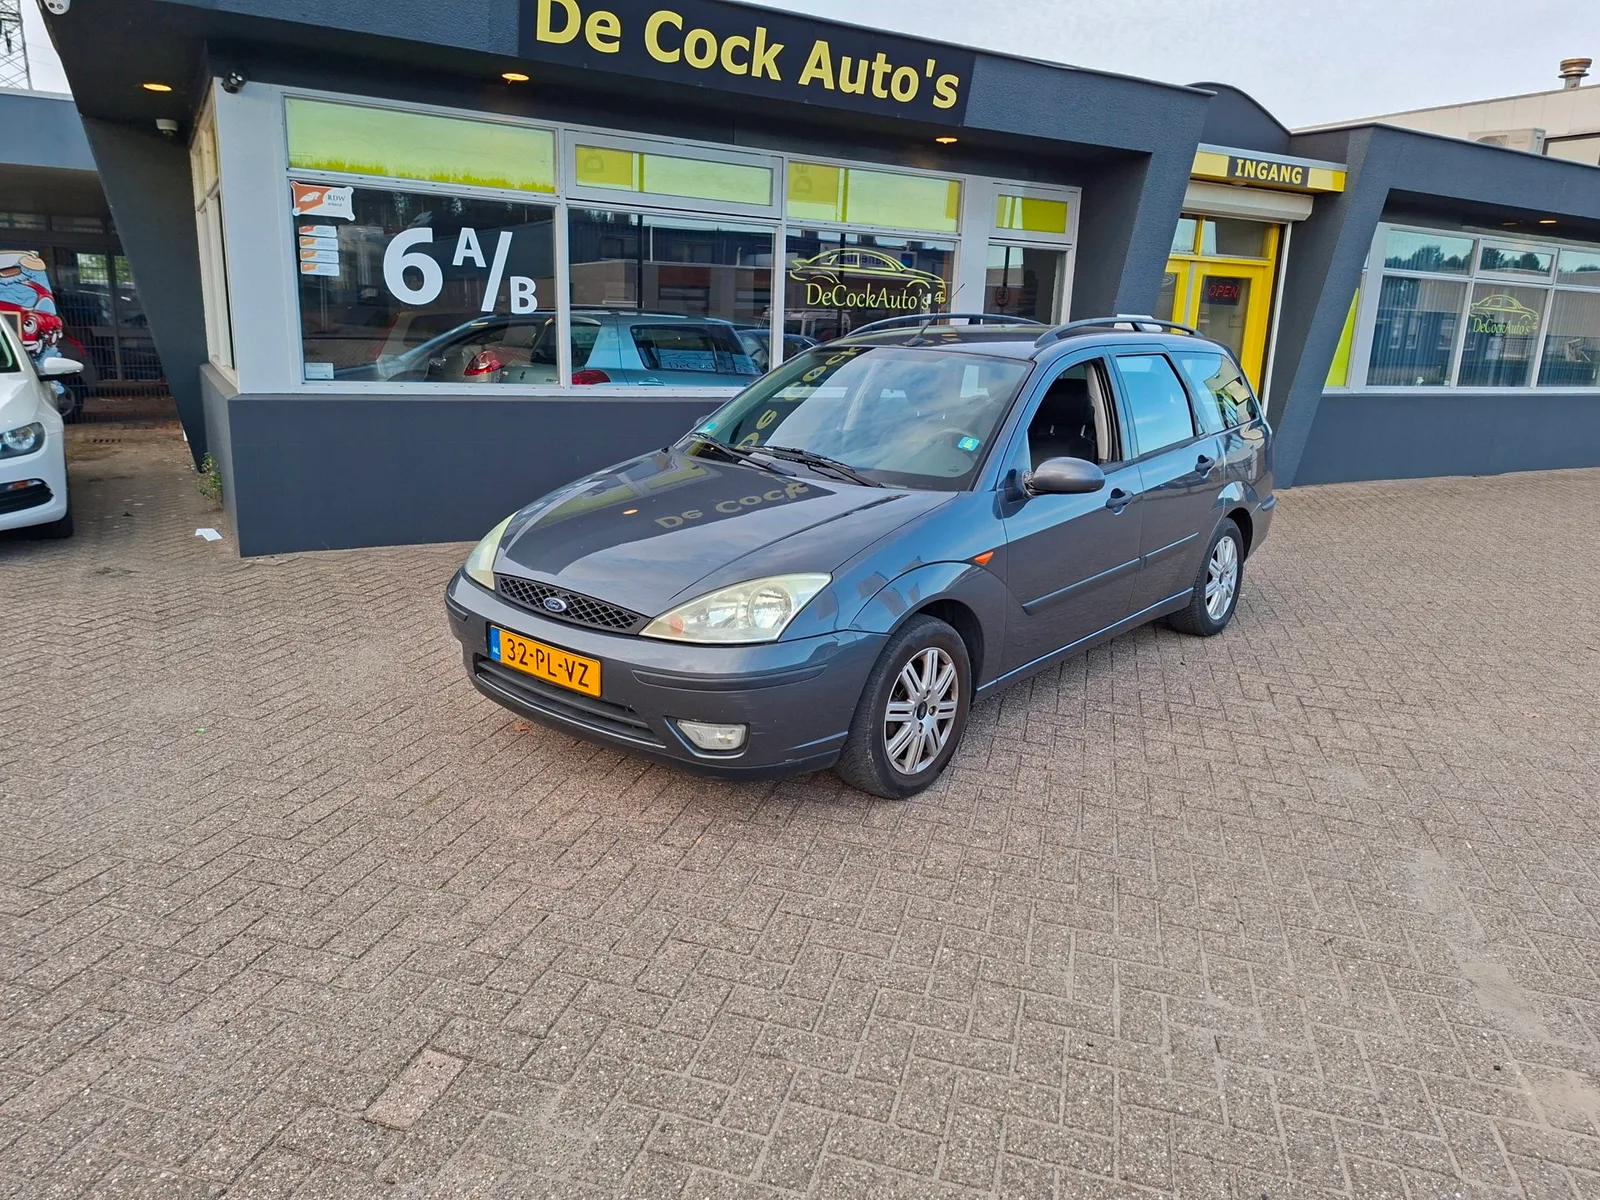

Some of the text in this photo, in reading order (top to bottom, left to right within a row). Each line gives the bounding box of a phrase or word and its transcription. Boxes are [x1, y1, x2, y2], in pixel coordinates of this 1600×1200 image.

[536, 0, 960, 109] De Cock Auto's
[1235, 159, 1303, 184] INGANG
[327, 194, 346, 202] RDW
[383, 227, 443, 305] 6
[806, 283, 929, 310] DeCockAuto's
[1208, 285, 1240, 298] OPEN
[1473, 317, 1530, 335] DeCockAuto's
[492, 646, 501, 655] NL
[507, 638, 589, 688] 32-PL-VZ
